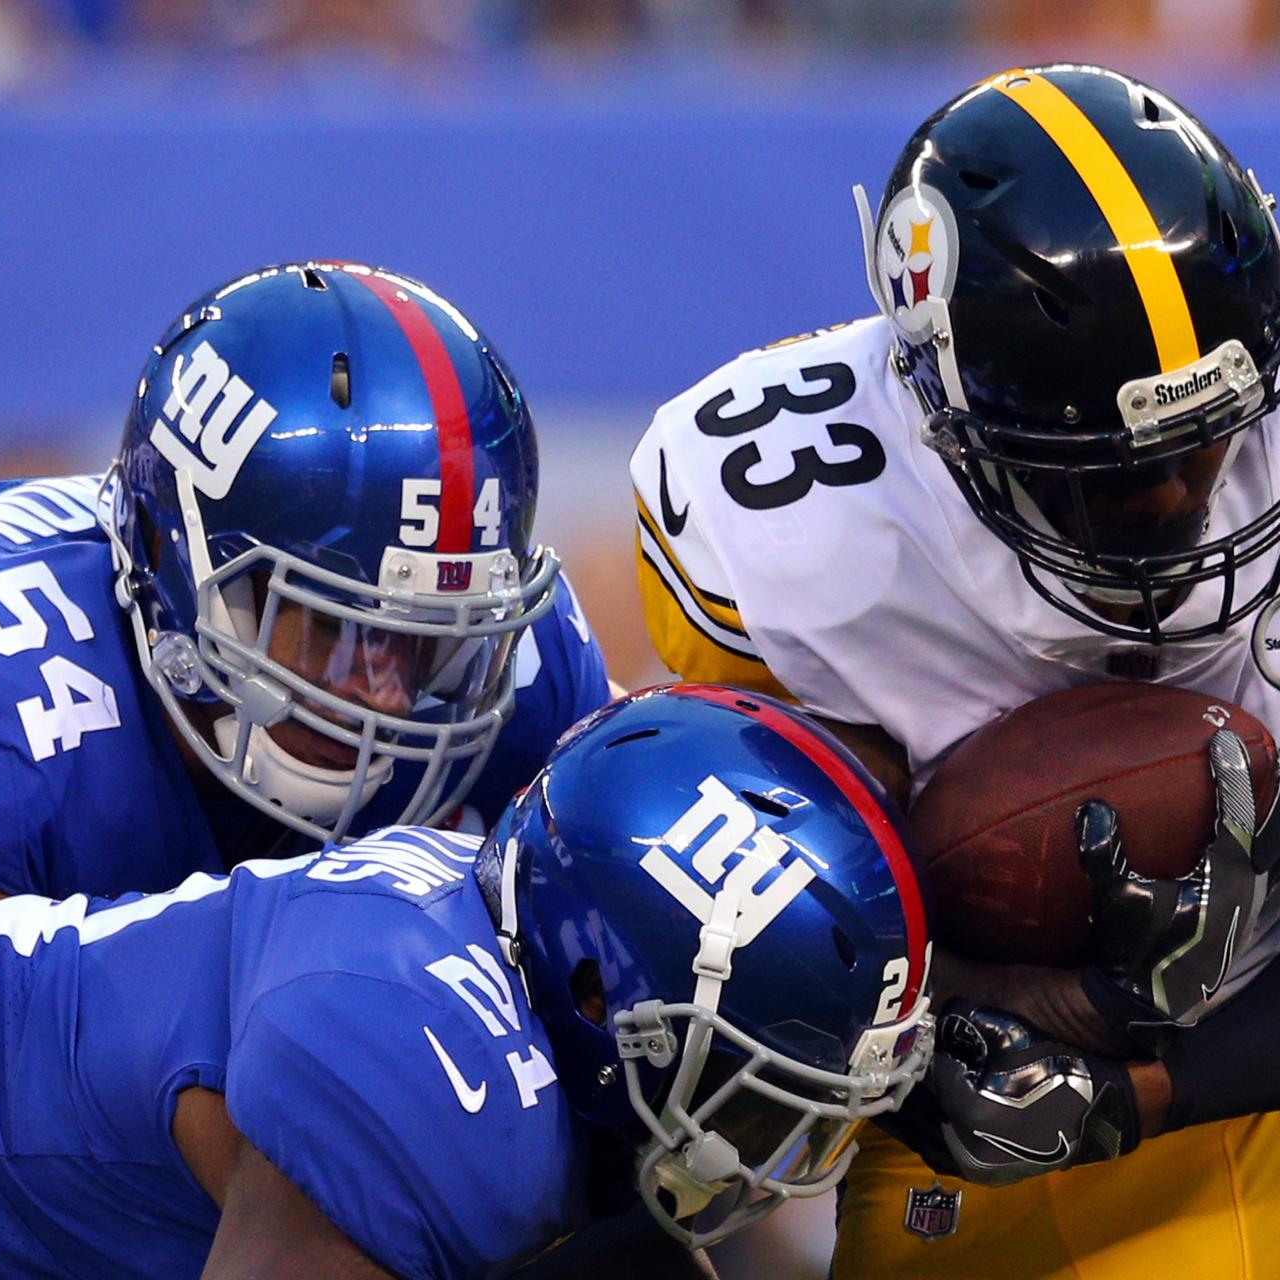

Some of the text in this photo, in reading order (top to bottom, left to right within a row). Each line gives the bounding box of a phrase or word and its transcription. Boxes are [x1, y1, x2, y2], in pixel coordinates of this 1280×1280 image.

[1154, 366, 1222, 406] Steelers
[695, 360, 888, 511] 33
[398, 478, 501, 547] 54
